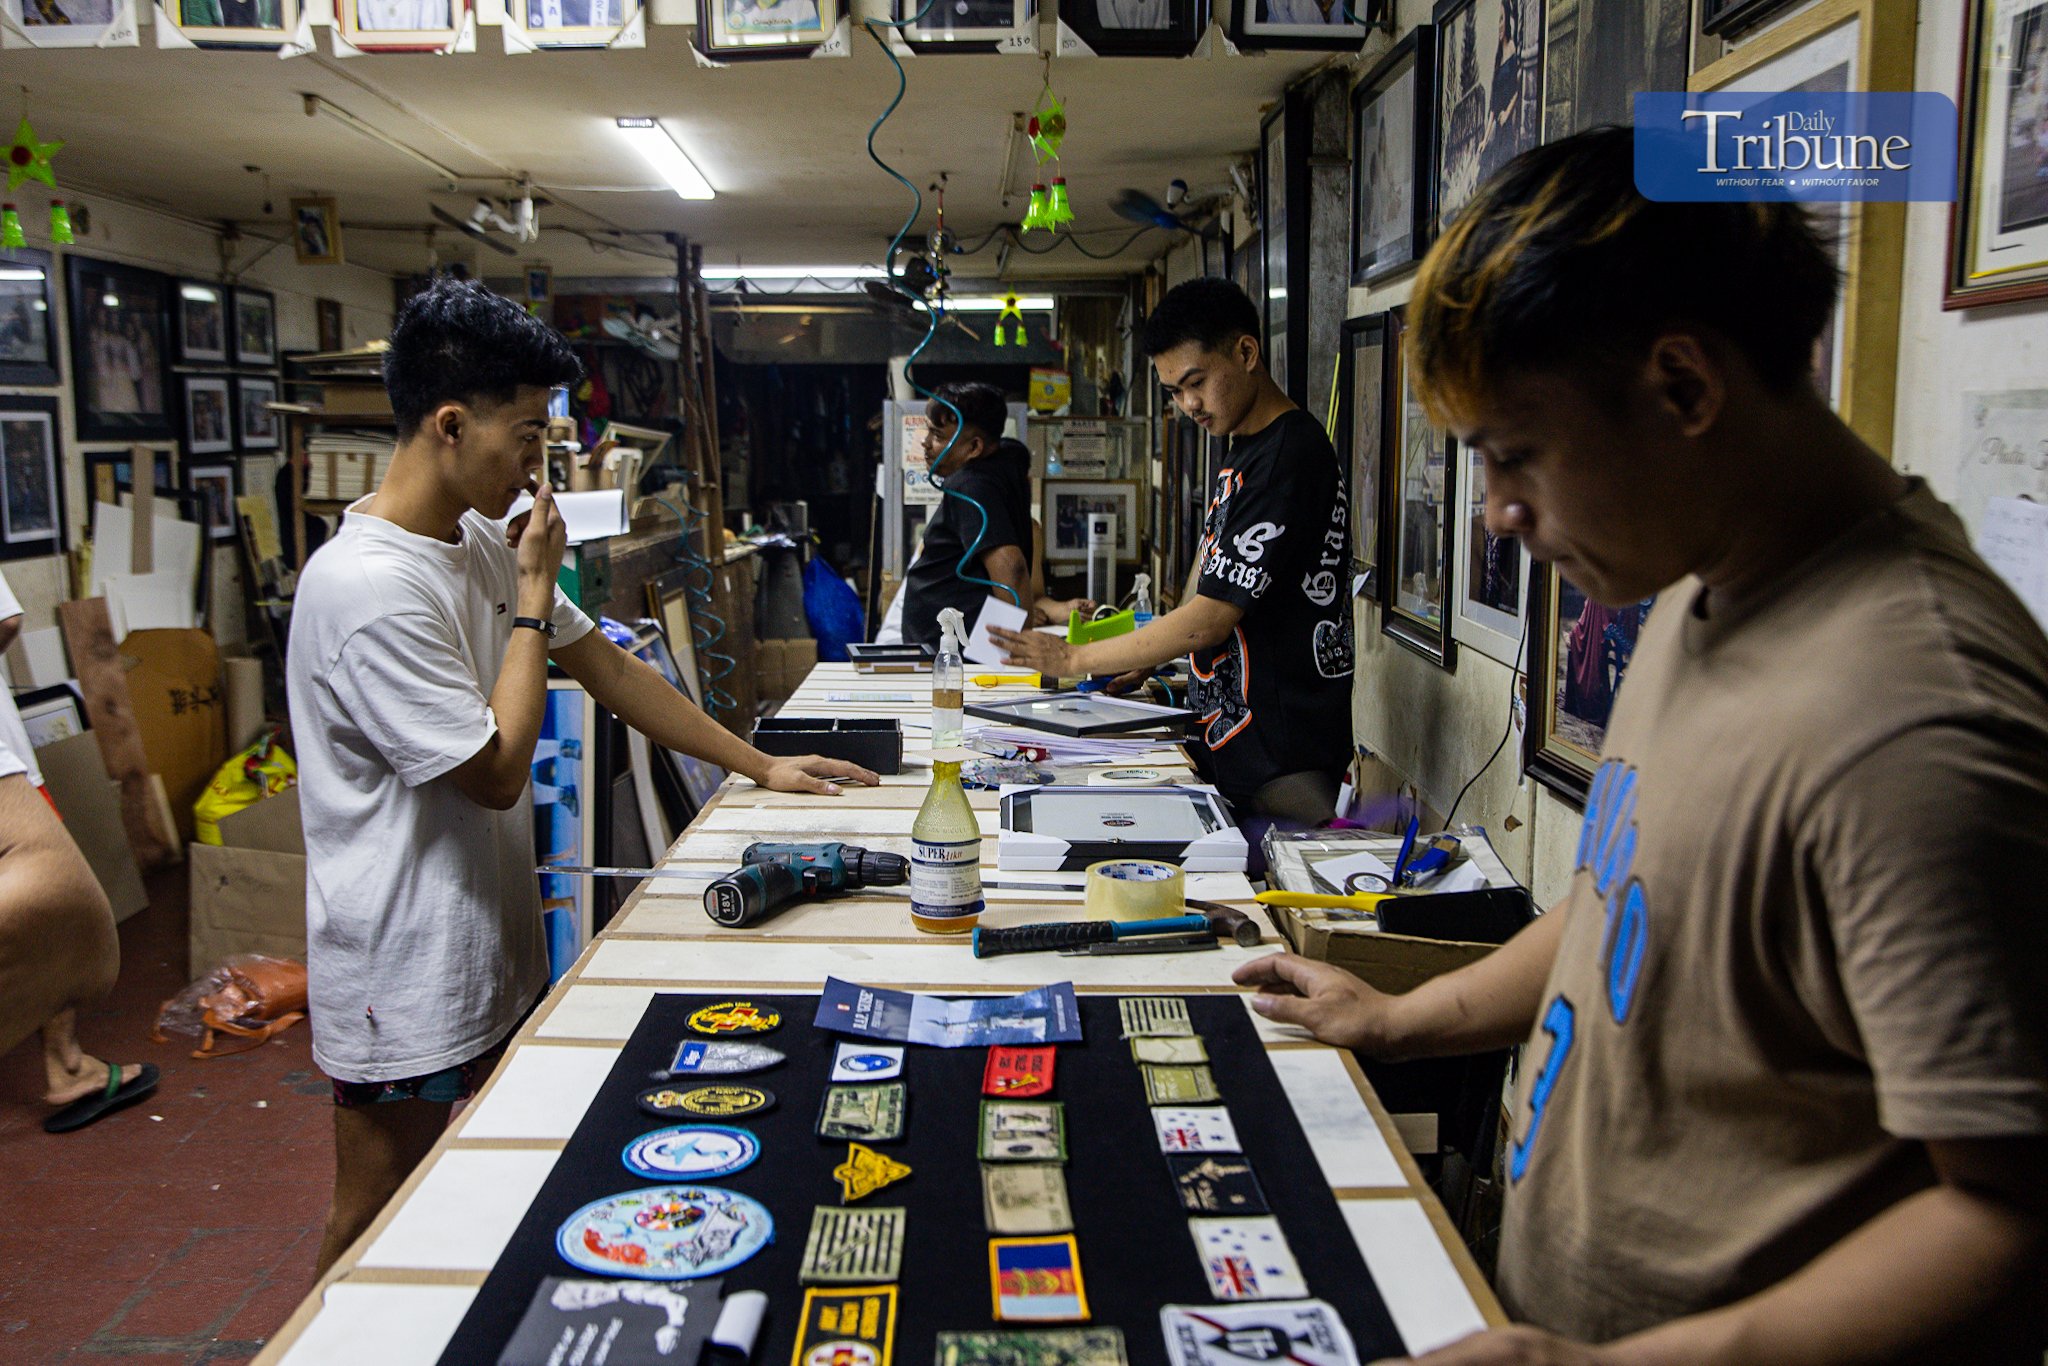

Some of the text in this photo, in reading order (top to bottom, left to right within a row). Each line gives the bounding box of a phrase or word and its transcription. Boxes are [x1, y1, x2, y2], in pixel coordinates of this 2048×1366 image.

[1009, 37, 1031, 47] 150
[918, 846, 946, 861] SUPER
[721, 893, 731, 914] 18V
